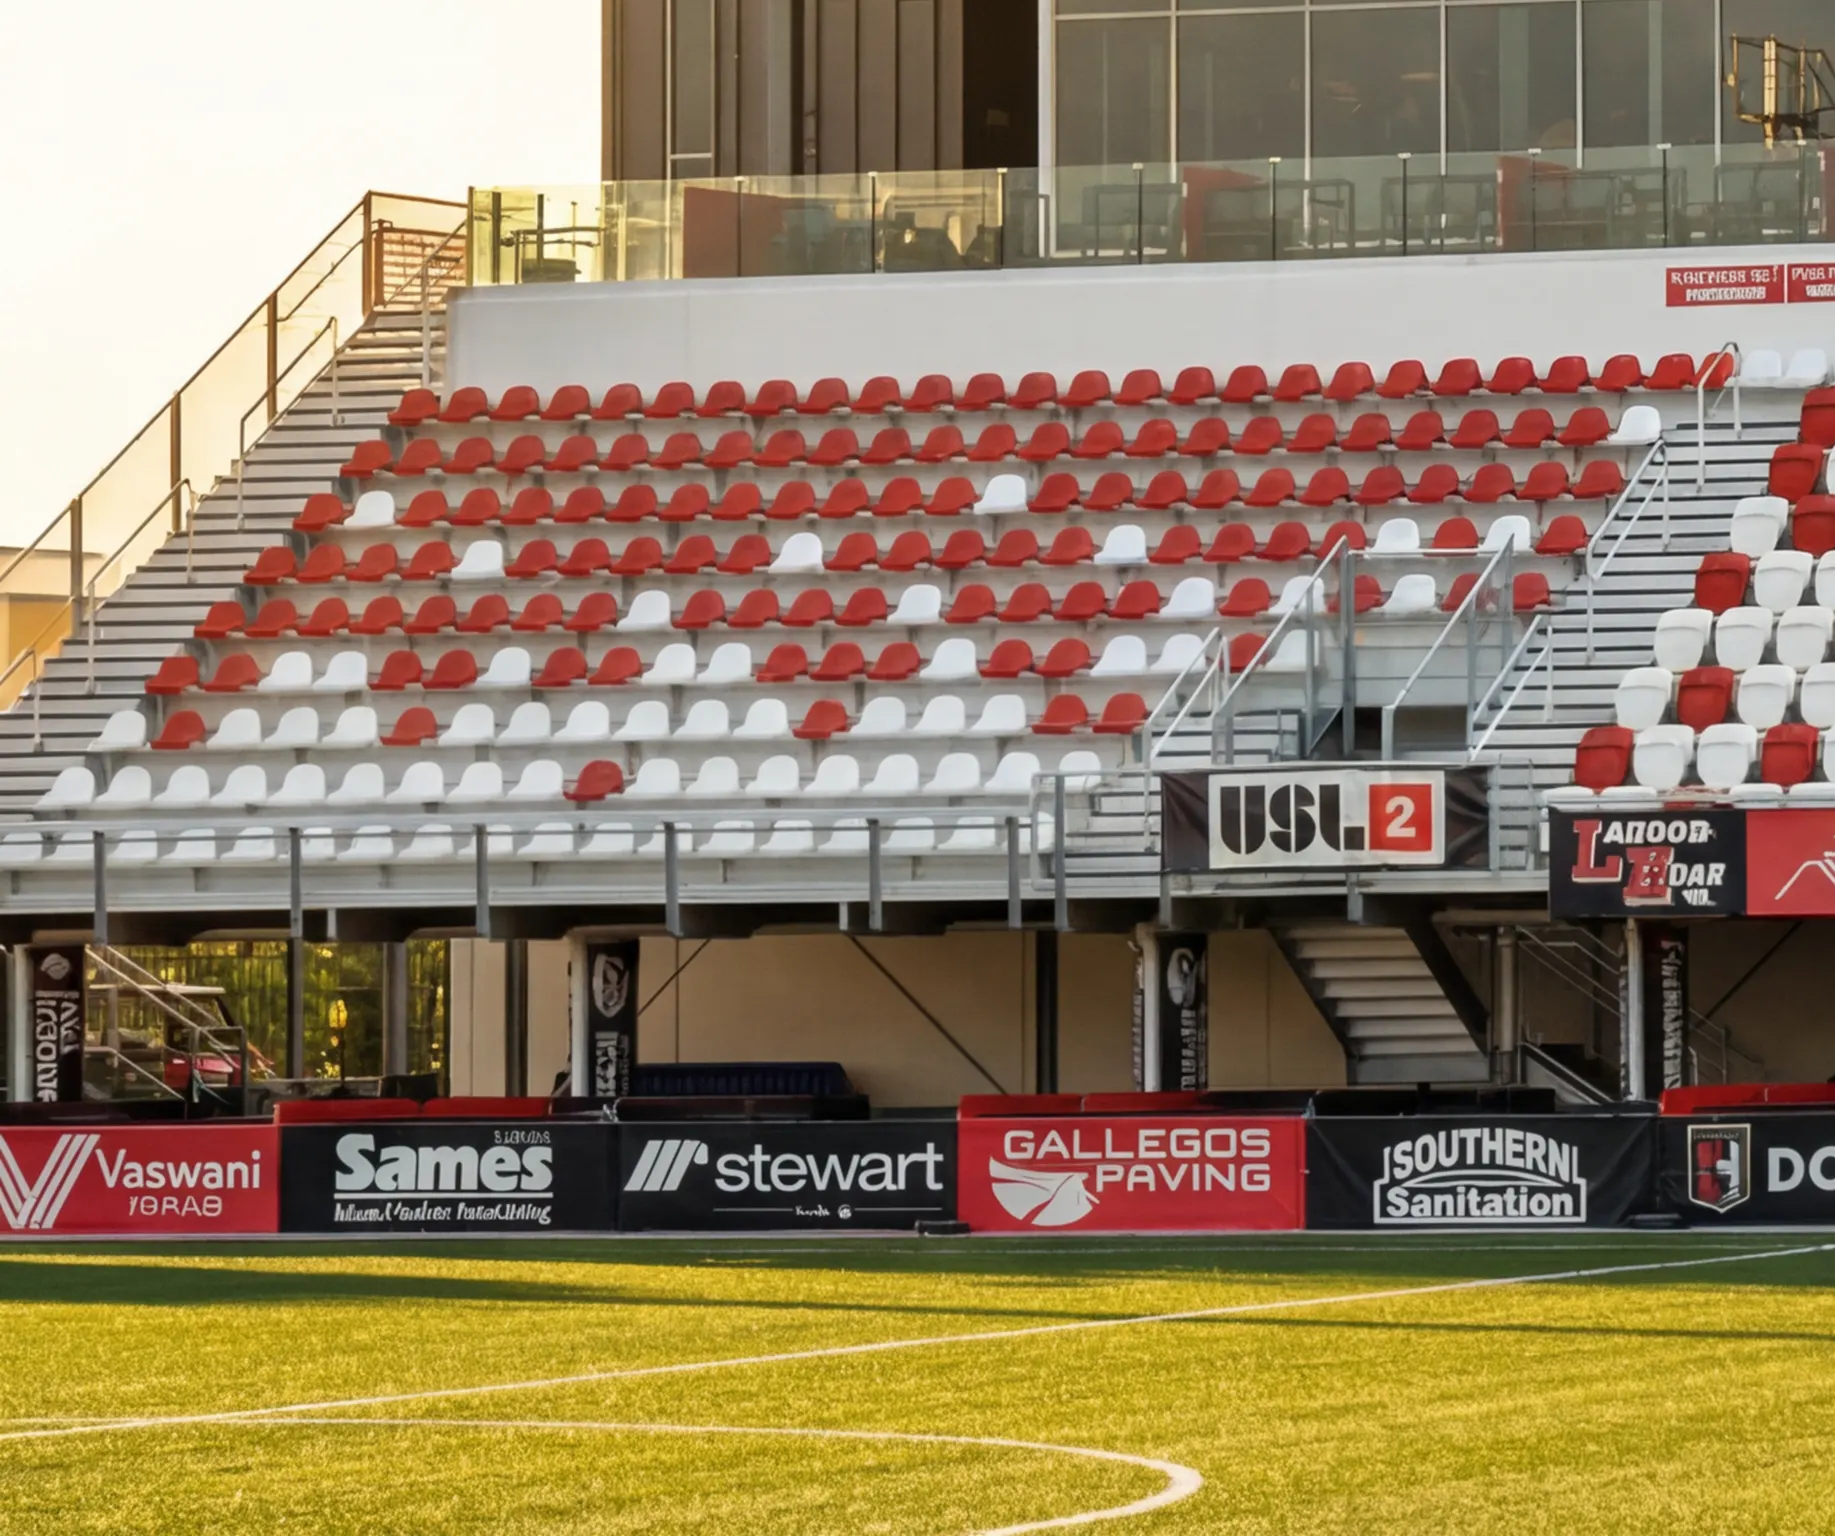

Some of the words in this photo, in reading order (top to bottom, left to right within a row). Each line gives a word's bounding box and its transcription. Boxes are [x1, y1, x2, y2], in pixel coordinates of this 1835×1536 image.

[1219, 783, 1365, 855] USL
[1384, 796, 1417, 838] 2
[335, 1133, 553, 1192] Sames
[1003, 1128, 1271, 1160] GALLEGOS
[1394, 1127, 1566, 1174] SOUTHERN
[95, 1148, 261, 1190] Vaswani
[714, 1142, 944, 1192] stewart
[1095, 1163, 1271, 1193] PAVING
[1386, 1185, 1574, 1218] Sanitation
